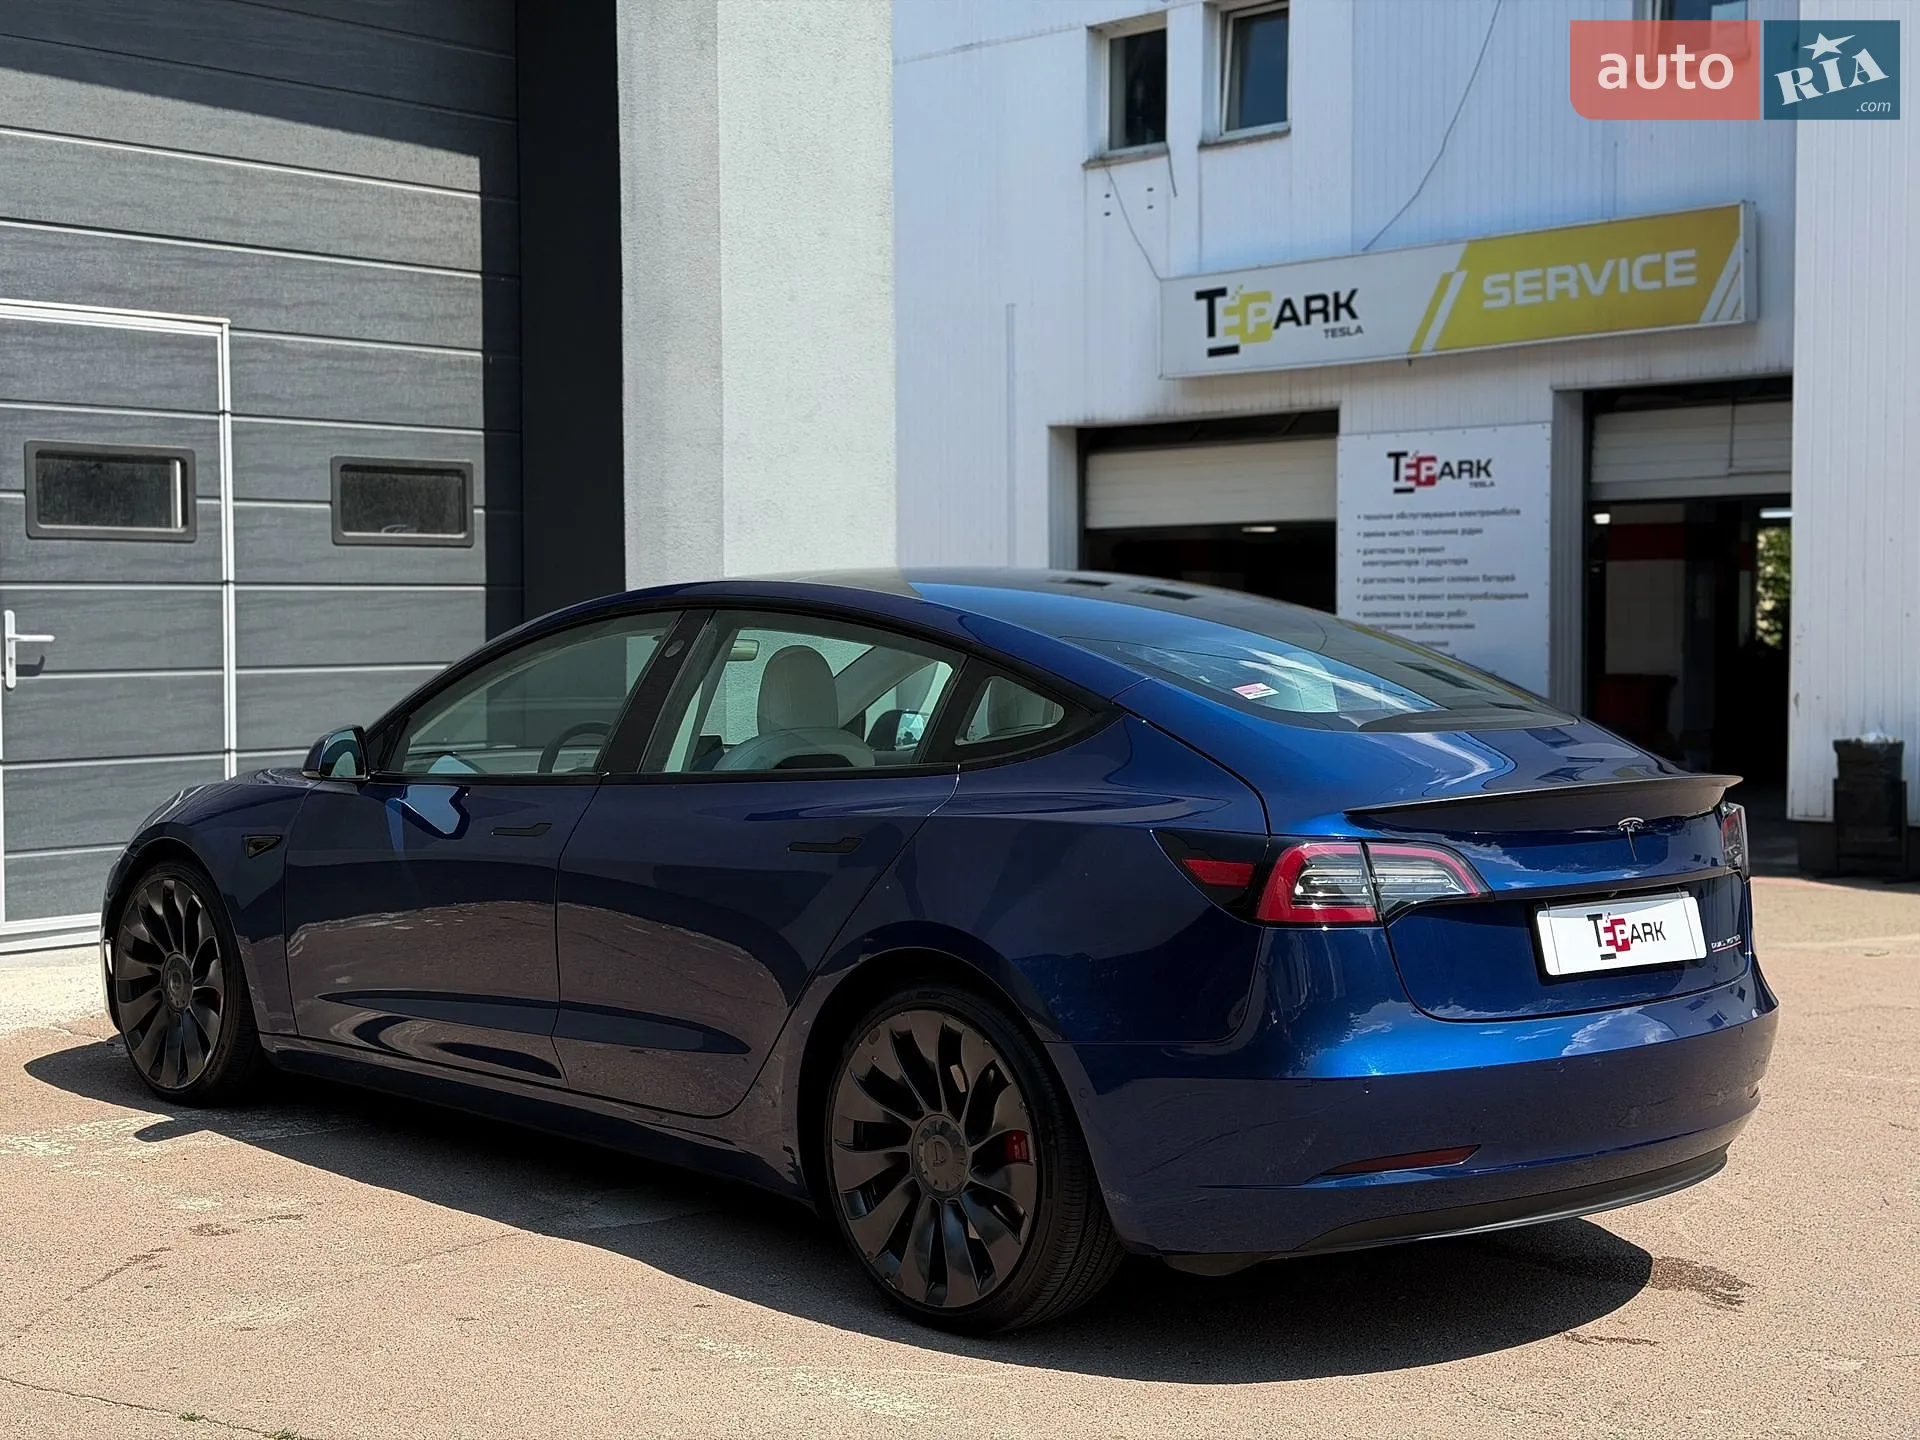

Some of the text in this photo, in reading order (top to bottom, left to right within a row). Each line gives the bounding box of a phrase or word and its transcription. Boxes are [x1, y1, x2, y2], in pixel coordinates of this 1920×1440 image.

[1483, 248, 1698, 309] SERVICE
[1323, 324, 1365, 339] TESLA
[1468, 480, 1496, 489] TESLA
